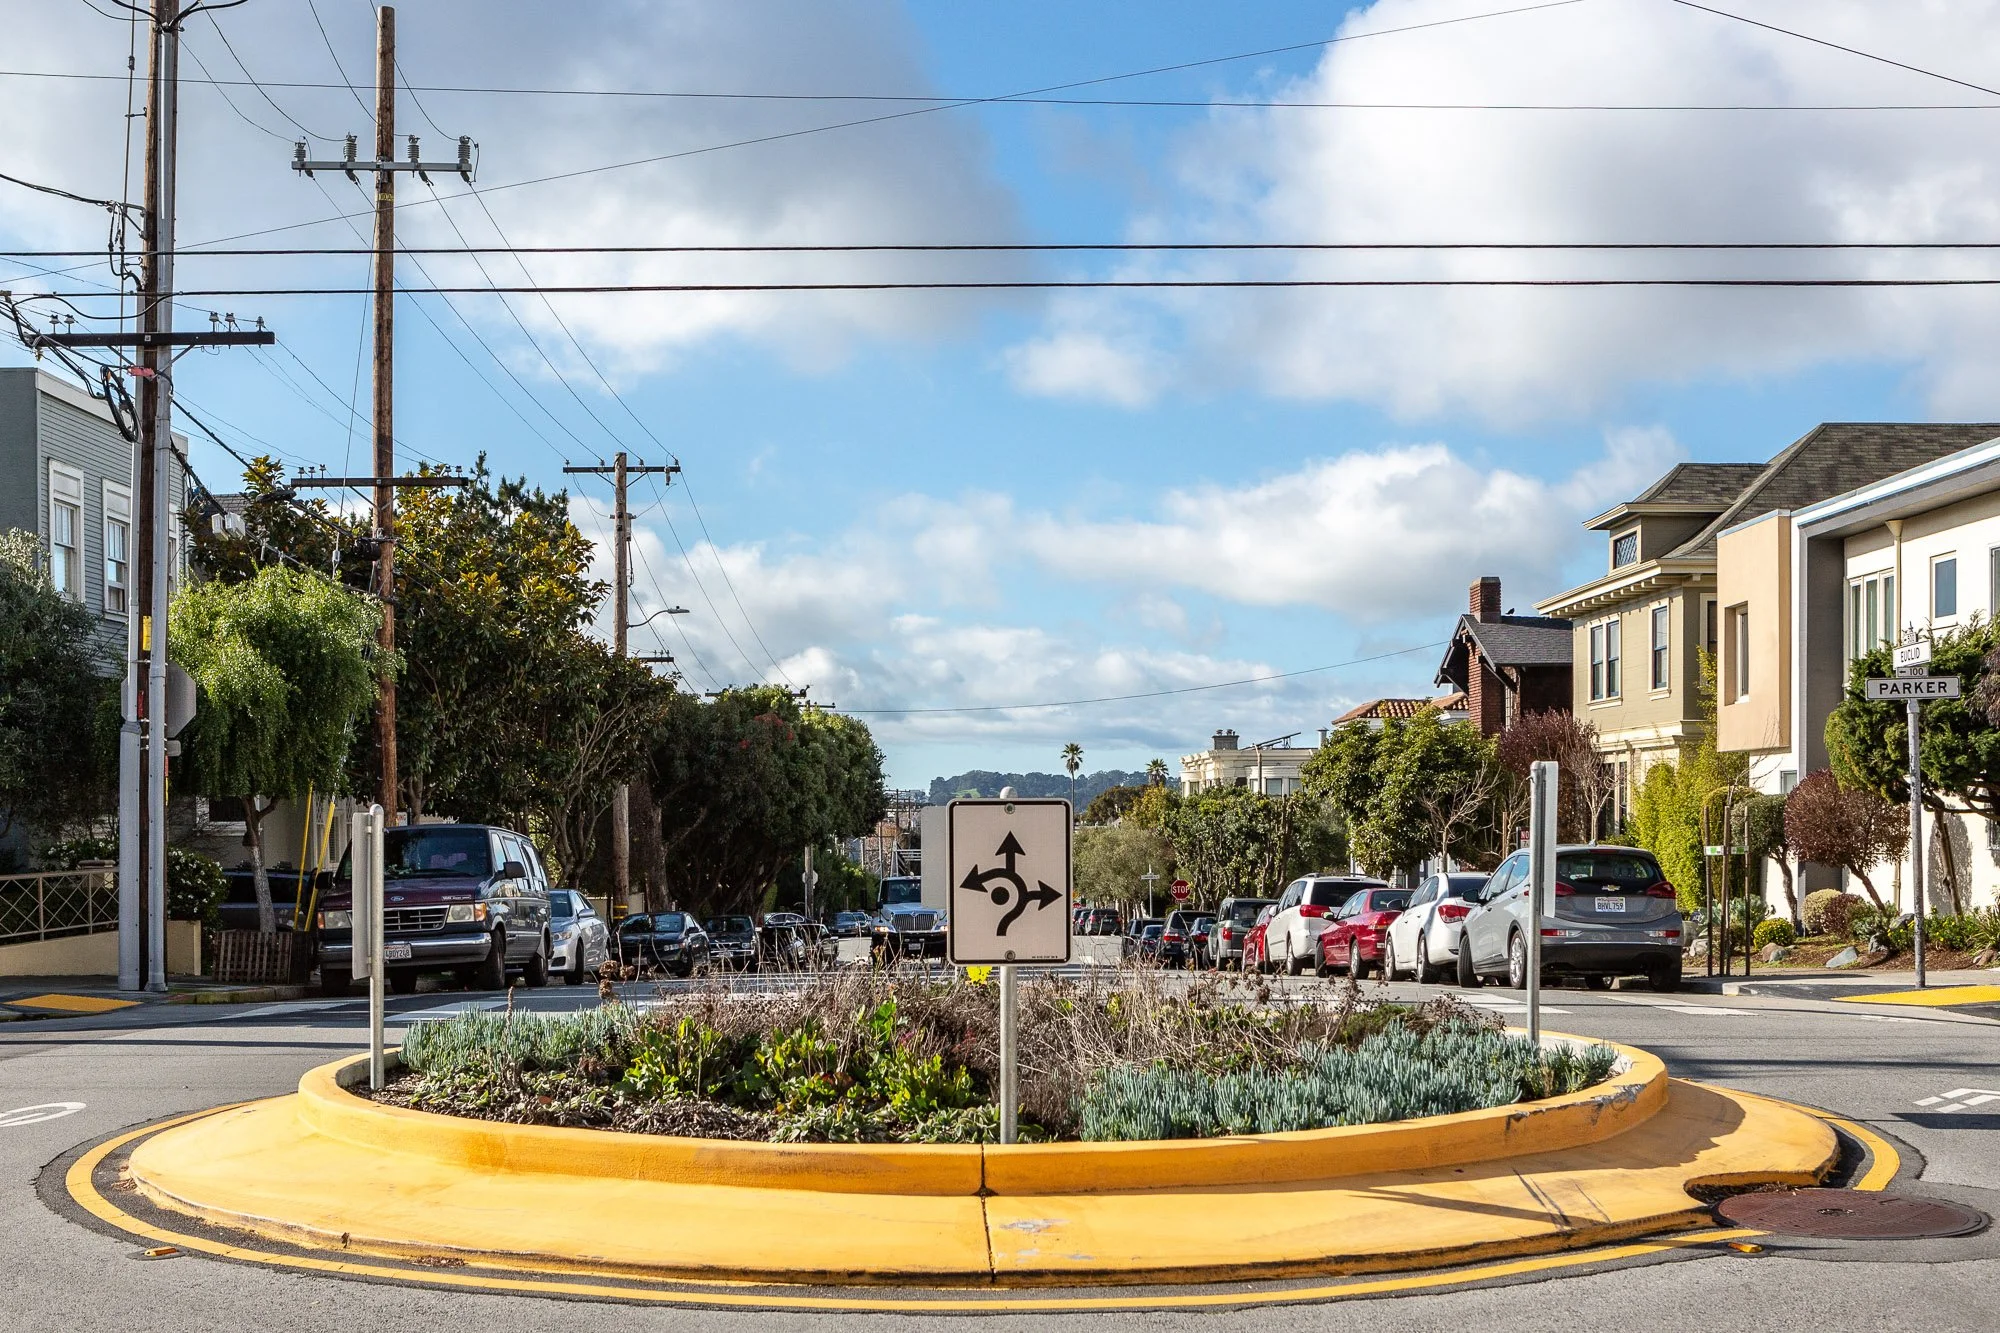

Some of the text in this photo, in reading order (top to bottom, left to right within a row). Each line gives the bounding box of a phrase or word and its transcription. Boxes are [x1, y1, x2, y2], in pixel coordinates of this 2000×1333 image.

[1901, 647, 1920, 663] EUCLID
[1910, 667, 1924, 676] 100
[1879, 681, 1947, 695] PARKER
[1520, 830, 1530, 839] NO
[1172, 885, 1190, 894] STOP
